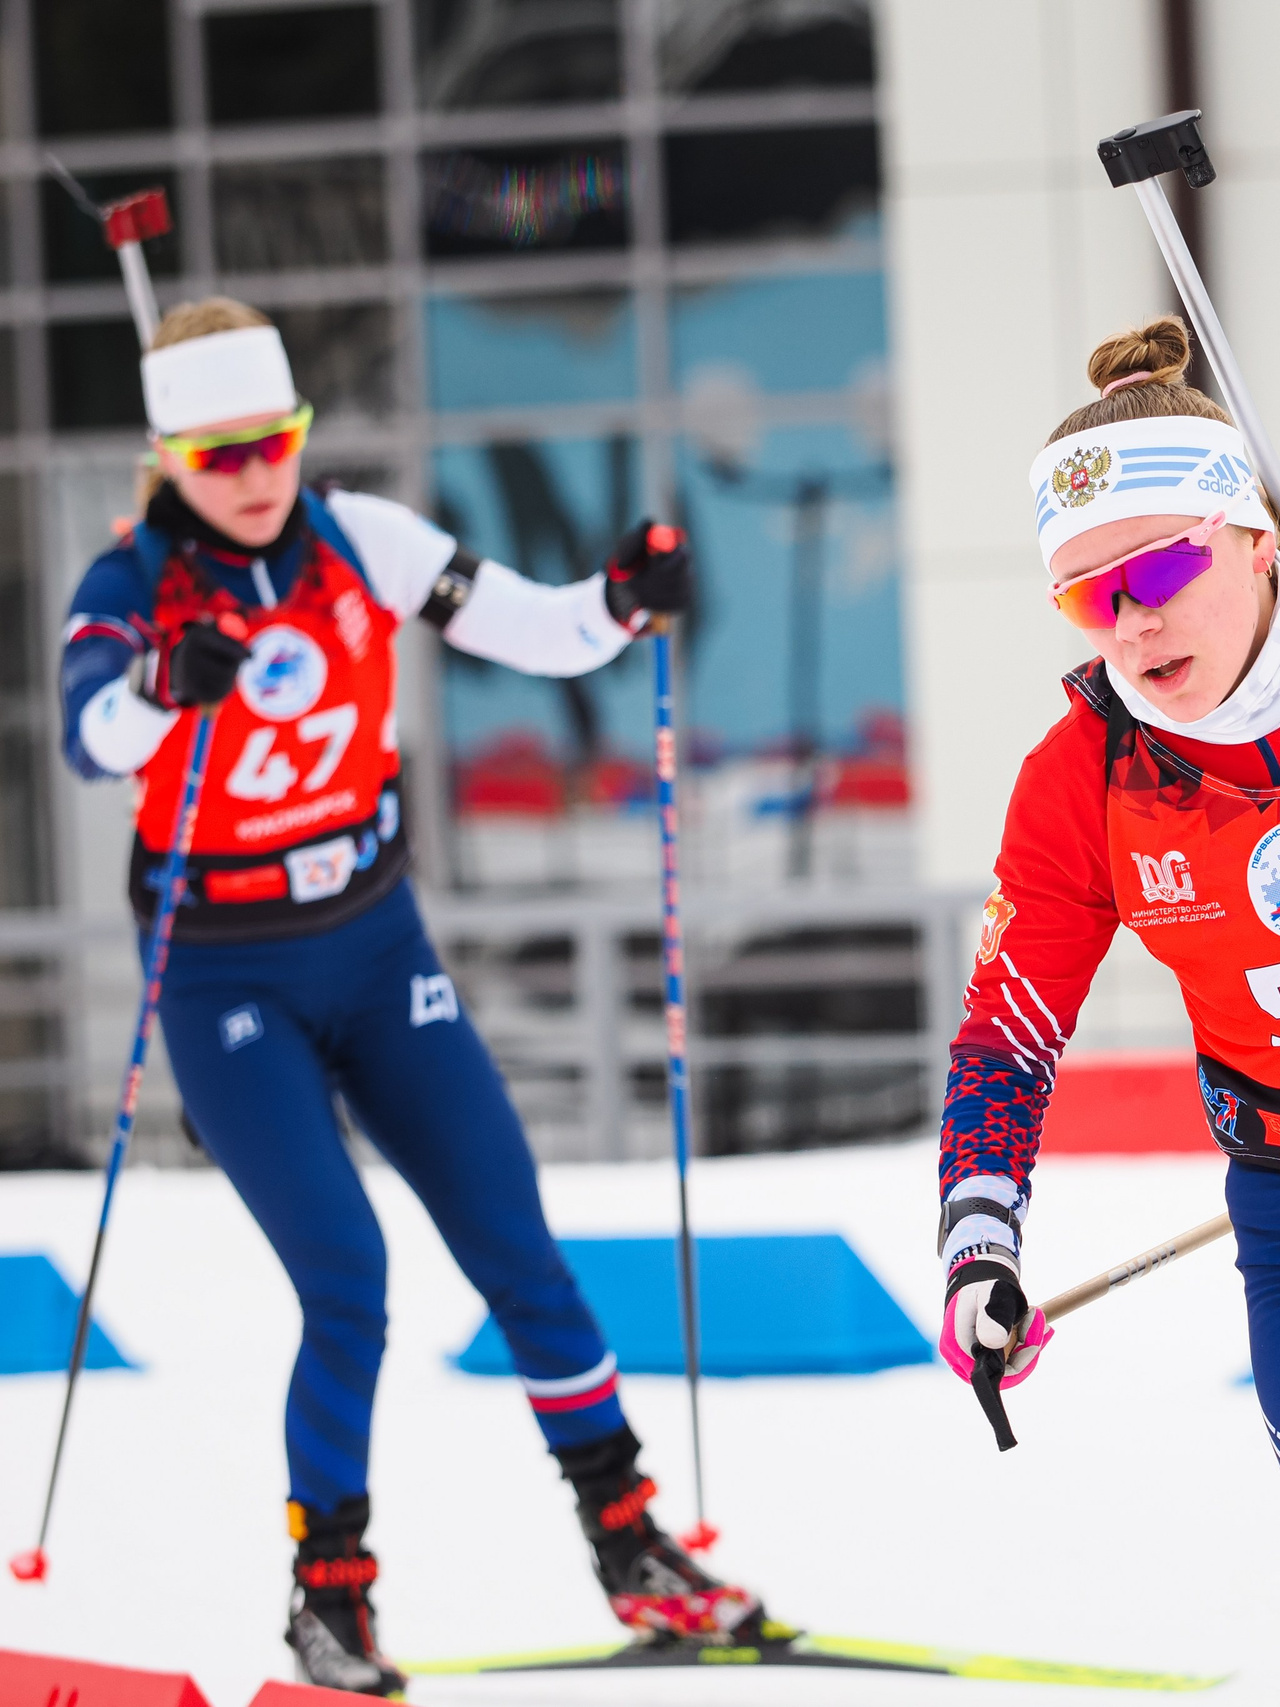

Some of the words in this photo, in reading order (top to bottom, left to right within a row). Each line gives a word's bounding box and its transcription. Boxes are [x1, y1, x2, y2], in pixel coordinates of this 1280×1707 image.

[226, 703, 358, 803] 47
[1174, 862, 1191, 873] ЛЕТ
[1128, 914, 1178, 928] РОССИЙСКОЙ
[1178, 909, 1226, 923] ФЕДЕРАЦИИ
[1131, 905, 1192, 919] МИНИСТЕРСТВО
[1192, 901, 1221, 912] СПОРТА
